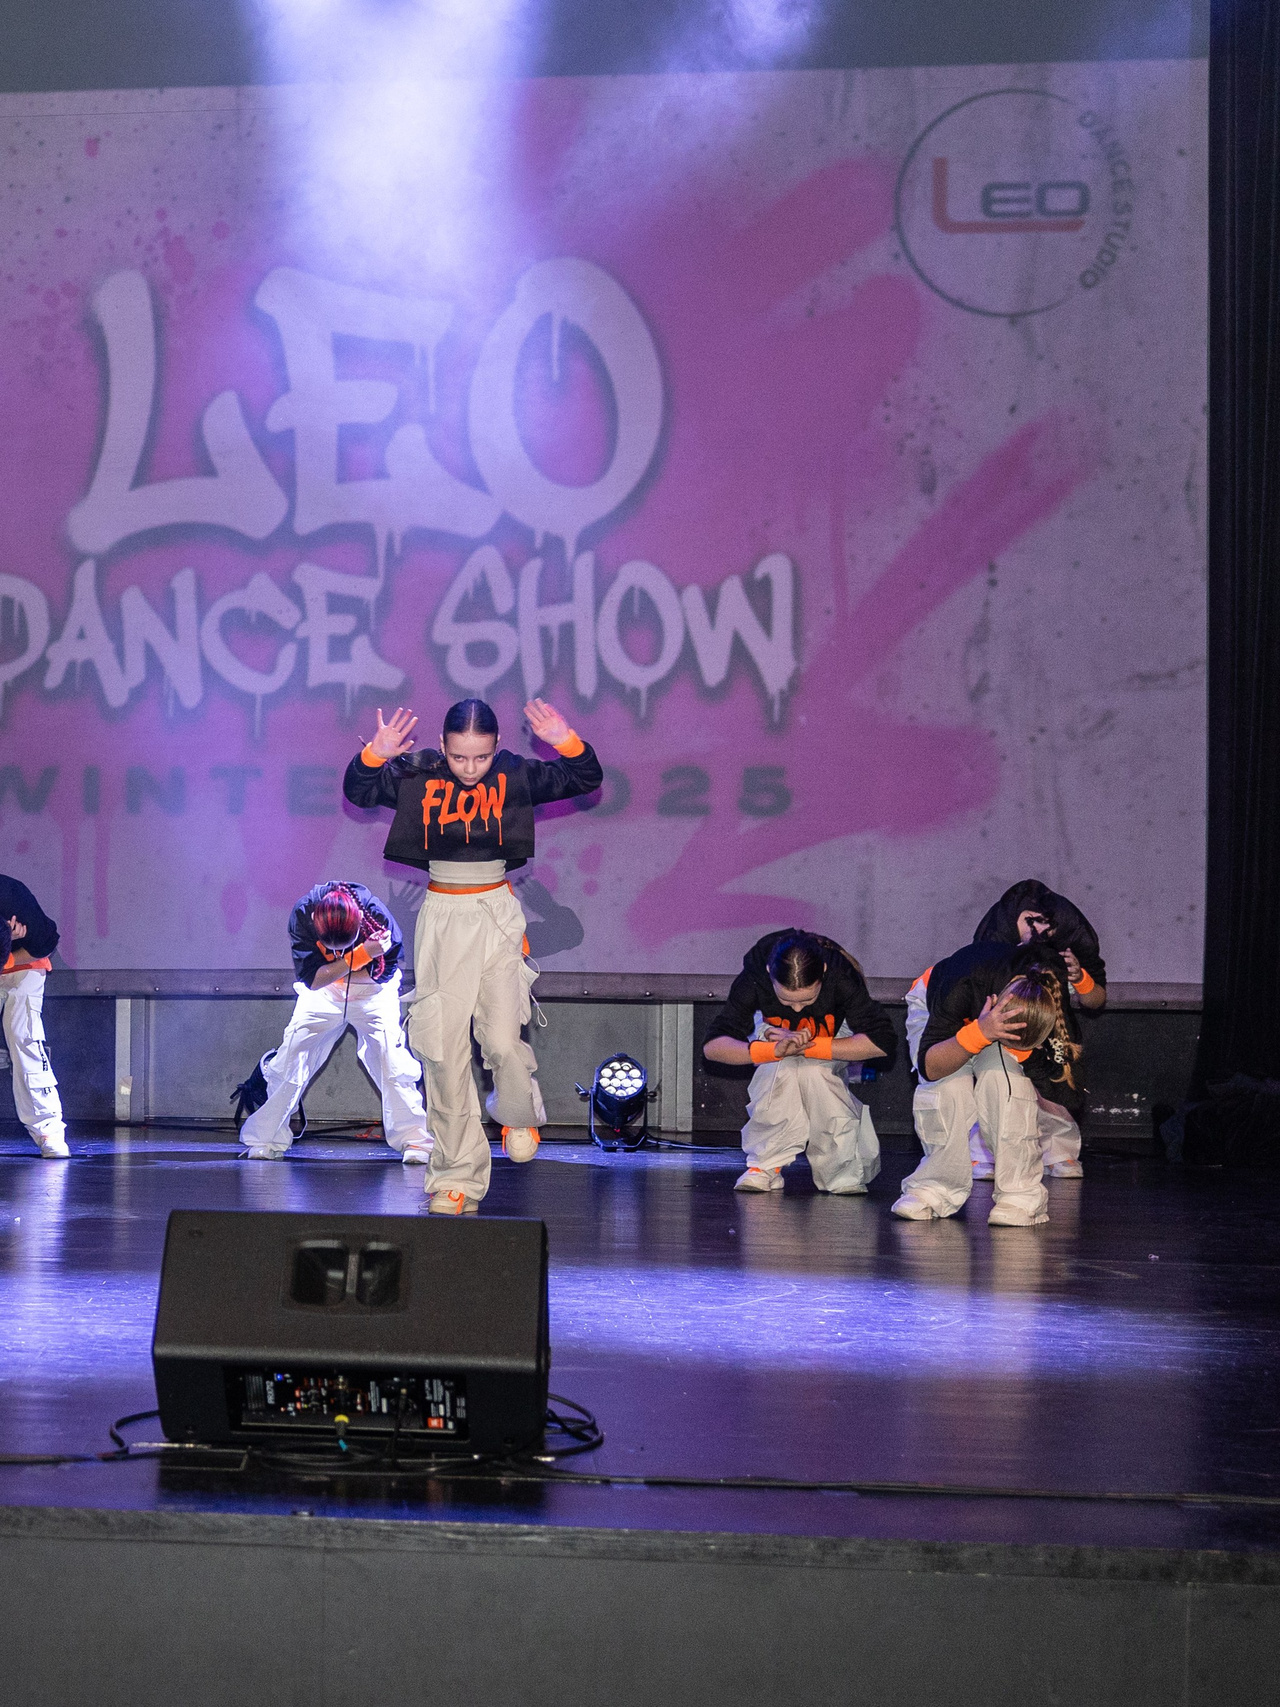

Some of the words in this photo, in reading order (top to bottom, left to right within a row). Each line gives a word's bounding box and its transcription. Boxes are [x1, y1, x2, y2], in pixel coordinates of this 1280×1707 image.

[1079, 111, 1133, 194] DANCE
[932, 157, 1090, 234] LEO
[1079, 199, 1132, 289] STUDIO
[66, 257, 664, 564] LEO
[431, 543, 798, 718] SHOW
[421, 772, 507, 850] FLOW
[535, 764, 794, 819] 025
